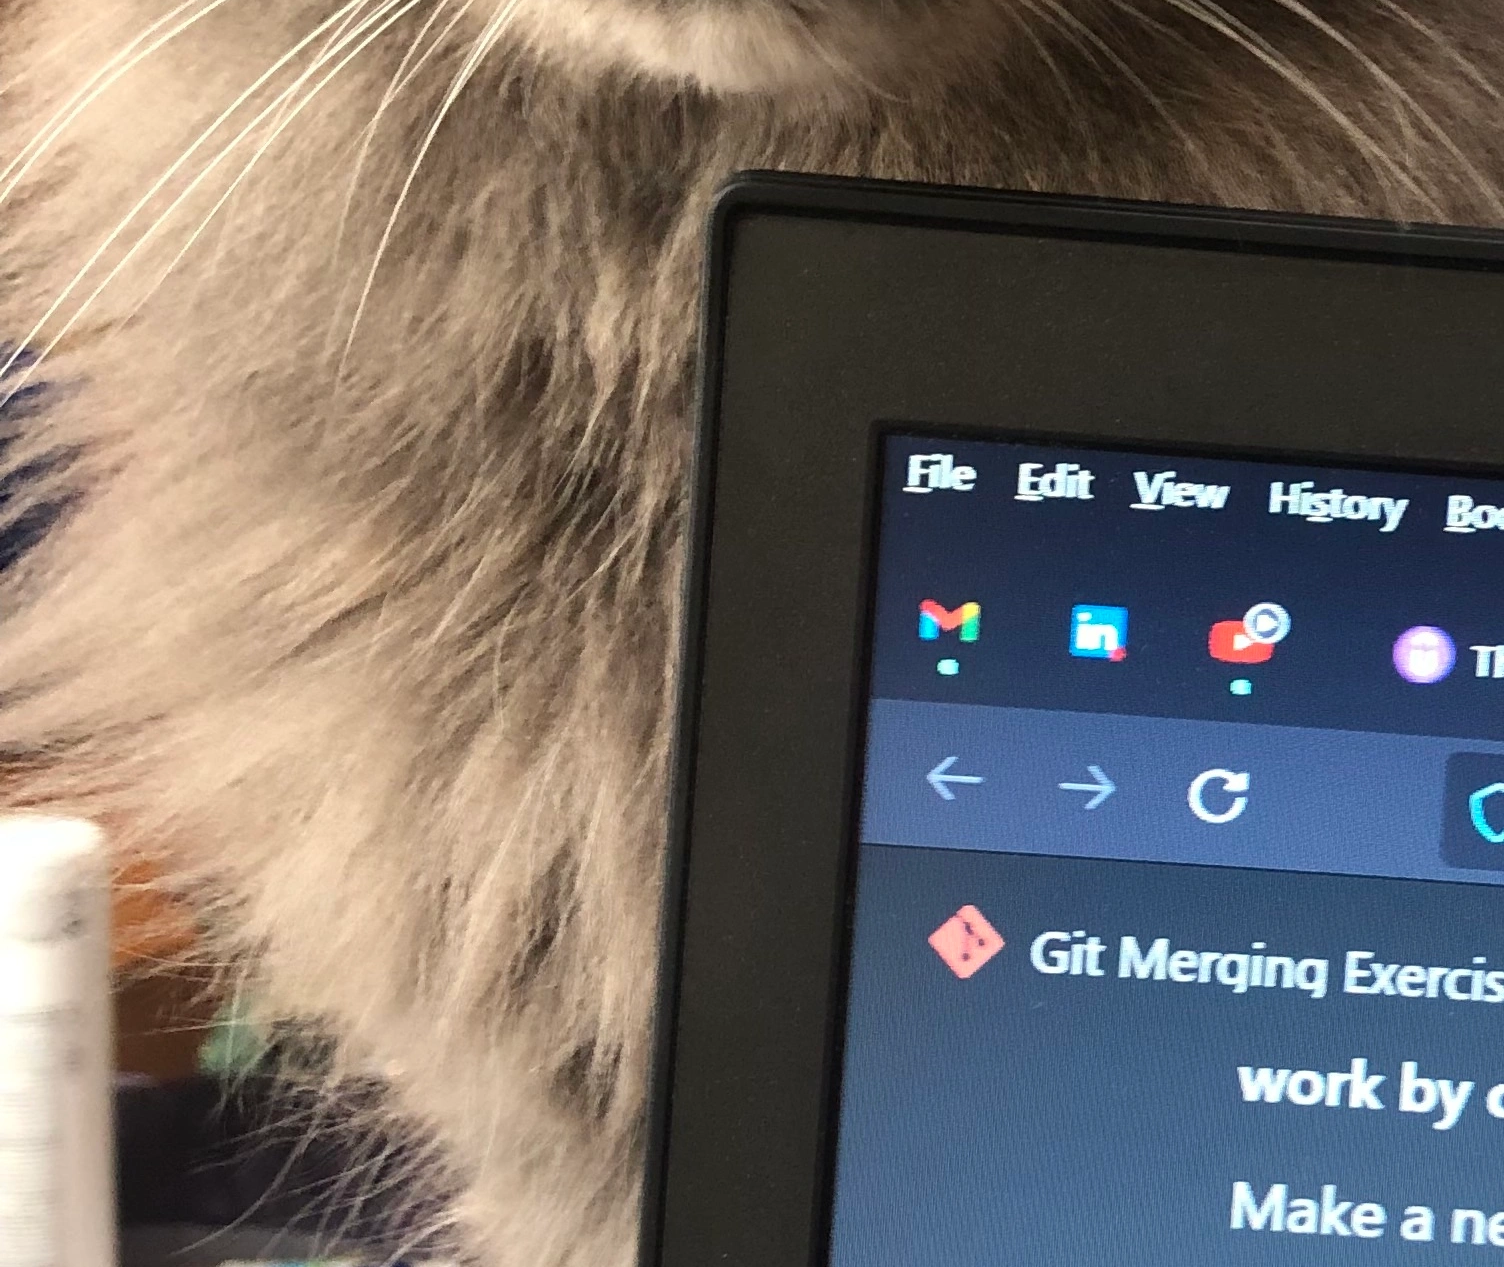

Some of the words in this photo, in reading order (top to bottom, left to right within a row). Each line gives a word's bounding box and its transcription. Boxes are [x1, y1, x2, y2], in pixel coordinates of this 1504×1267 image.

[904, 453, 977, 493] File
[1014, 462, 1096, 501] Edit
[1131, 470, 1231, 511] View
[1268, 480, 1410, 533] History
[1030, 929, 1107, 977] Git
[1118, 936, 1328, 999] Merging
[1237, 1057, 1386, 1112] work
[1400, 1061, 1474, 1130] by
[1229, 1181, 1387, 1241] Make
[1400, 1206, 1434, 1243] a
